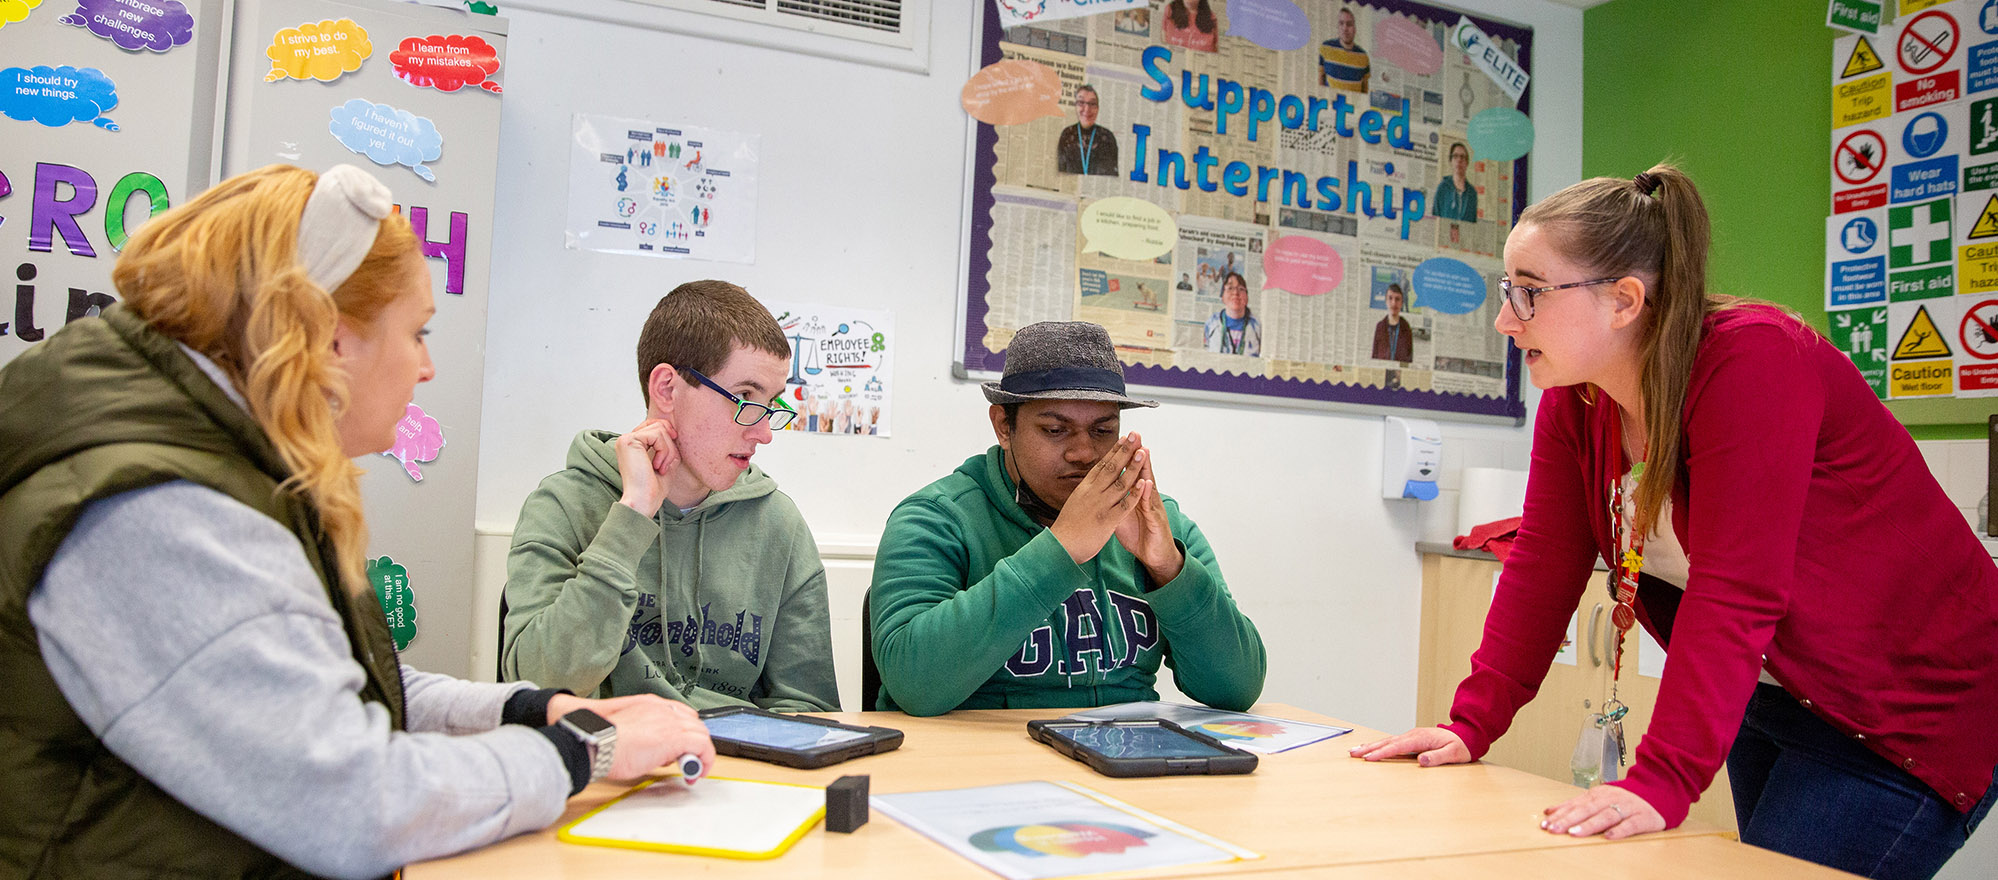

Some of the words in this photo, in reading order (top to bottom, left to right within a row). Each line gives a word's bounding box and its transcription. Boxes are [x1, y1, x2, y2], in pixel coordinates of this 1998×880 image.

[115, 0, 164, 17] mbrace
[118, 9, 144, 23] new
[1833, 2, 1859, 20] First
[1860, 11, 1880, 25] aid
[93, 14, 157, 43] challenges.
[280, 35, 286, 45] I
[288, 34, 318, 44] strive
[320, 32, 331, 42] to
[333, 31, 348, 41] do
[294, 47, 311, 58] my
[313, 45, 340, 56] best.
[411, 42, 416, 52] I
[418, 43, 443, 54] learn
[446, 44, 470, 55] from
[408, 55, 424, 67] my
[427, 56, 475, 68] mistakes.
[1483, 46, 1526, 91] ELITE
[17, 73, 21, 82] I
[24, 75, 61, 86] should
[64, 77, 78, 89] try
[1839, 77, 1887, 98] Caution
[1917, 78, 1936, 91] No
[15, 86, 38, 96] new
[42, 87, 78, 100] things.
[1141, 45, 1414, 151] Supported
[1900, 88, 1955, 109] smoking
[1851, 95, 1874, 108] Trip
[365, 108, 370, 118] I
[371, 110, 409, 133] haven't
[1842, 106, 1882, 123] hazard
[351, 116, 387, 137] figured
[388, 130, 396, 141] it
[398, 135, 415, 148] out
[369, 137, 387, 152] yet.
[1130, 123, 1426, 241] Internship
[1908, 168, 1942, 183] Wear
[1894, 184, 1925, 199] hard
[1927, 180, 1956, 195] hats
[1966, 246, 1998, 260] Caut
[1981, 262, 1998, 273] Tri
[1891, 282, 1924, 294] First
[1928, 274, 1952, 290] aid
[1970, 278, 1998, 288] haza
[820, 338, 871, 352] EMPLOYEE
[826, 351, 866, 364] RIGHTS!
[1892, 367, 1952, 381] Caution
[1902, 384, 1919, 392] Wet
[1921, 382, 1942, 391] floor
[404, 414, 423, 432] help
[399, 425, 416, 439] and
[383, 574, 393, 584] at
[395, 579, 403, 593] am
[384, 584, 394, 609] this...
[396, 594, 403, 606] no
[637, 592, 656, 608] HE
[386, 610, 396, 629] YET
[394, 606, 406, 628] good
[709, 681, 746, 696] 1895
